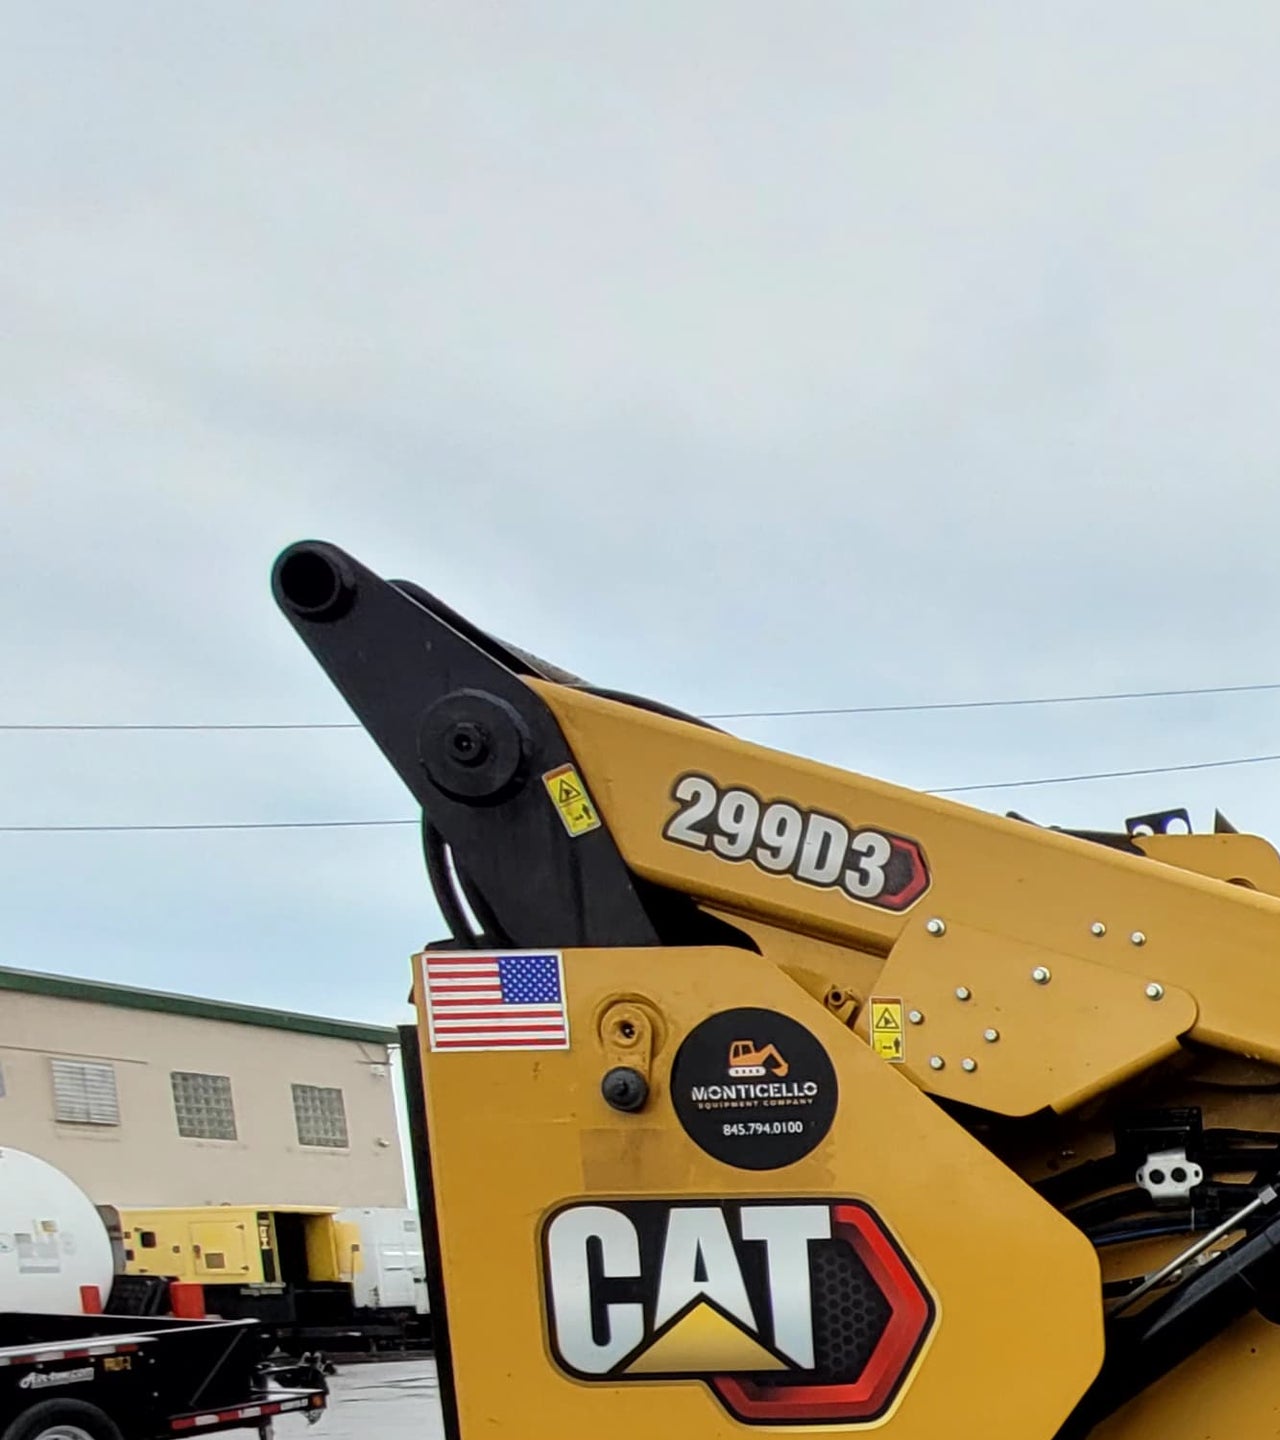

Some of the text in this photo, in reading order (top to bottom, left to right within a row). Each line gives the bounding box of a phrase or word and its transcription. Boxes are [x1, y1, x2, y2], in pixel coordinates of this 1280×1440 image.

[666, 776, 891, 898] 299D3
[691, 1081, 818, 1101] MONTICELLO
[698, 1098, 814, 1110] EQUIPMENT COMPANY
[722, 1121, 804, 1136] 845.794.0100
[548, 1205, 832, 1374] CAT
